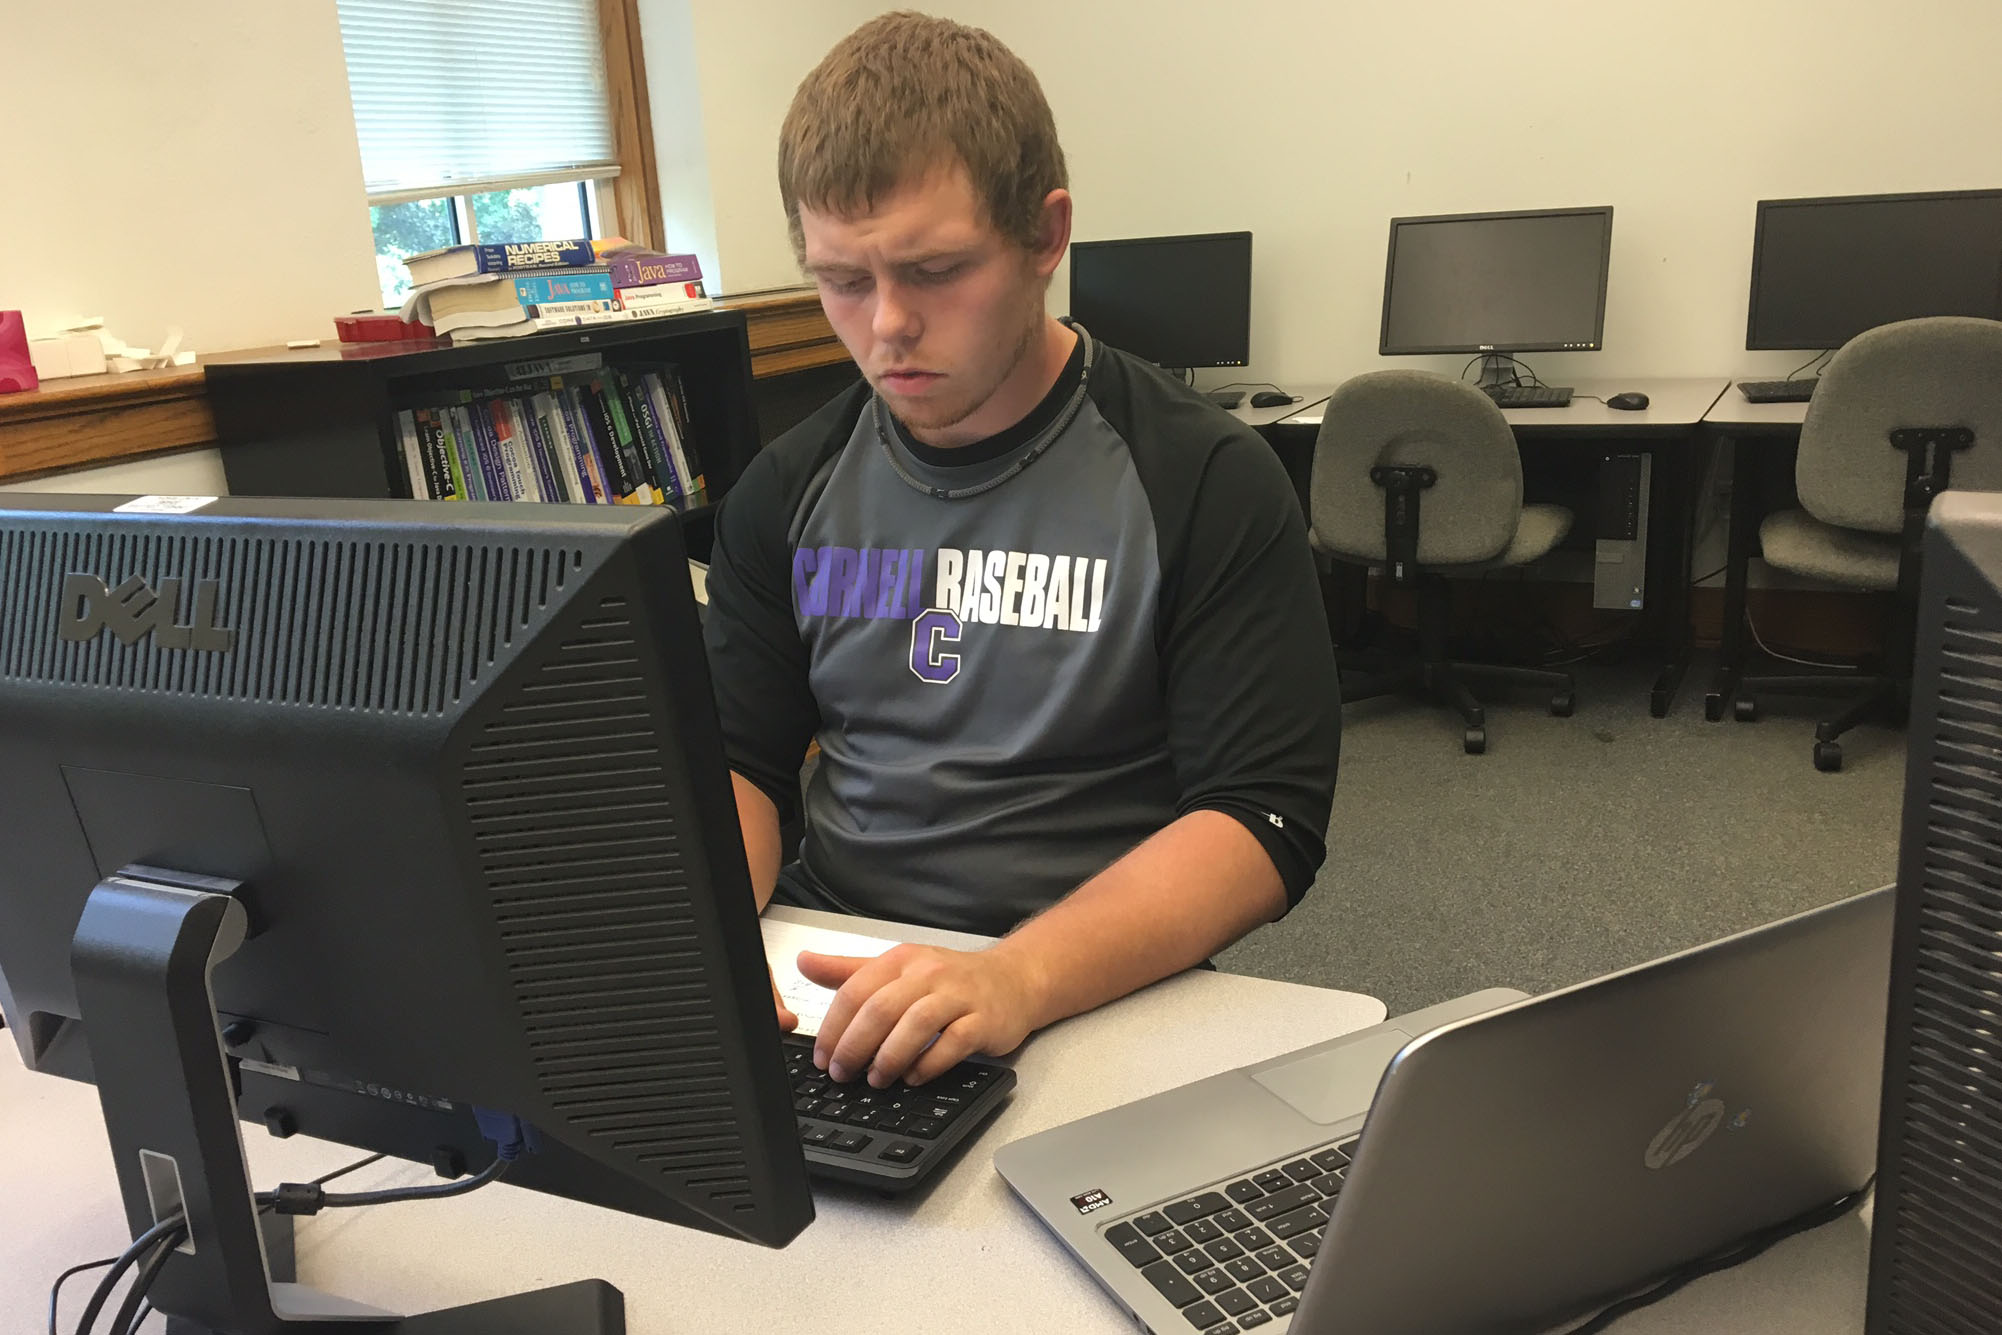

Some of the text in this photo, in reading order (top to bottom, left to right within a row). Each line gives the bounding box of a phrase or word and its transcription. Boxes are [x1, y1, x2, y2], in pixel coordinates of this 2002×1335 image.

[505, 240, 579, 255] NUMERICAL
[507, 251, 560, 266] RECIPES
[636, 260, 666, 284] Java
[436, 429, 454, 492] Objective-C
[491, 439, 502, 470] Design
[499, 471, 511, 501] Pattern
[503, 442, 520, 499] Programming
[508, 440, 525, 495] Cocoa Touch
[568, 423, 588, 478] Programming
[608, 431, 627, 478] Development
[59, 572, 236, 652] DELL
[935, 547, 1108, 633] BASEBALL
[909, 607, 963, 684] C
[1085, 1192, 1102, 1202] A10
[1088, 1198, 1110, 1210] AMD
